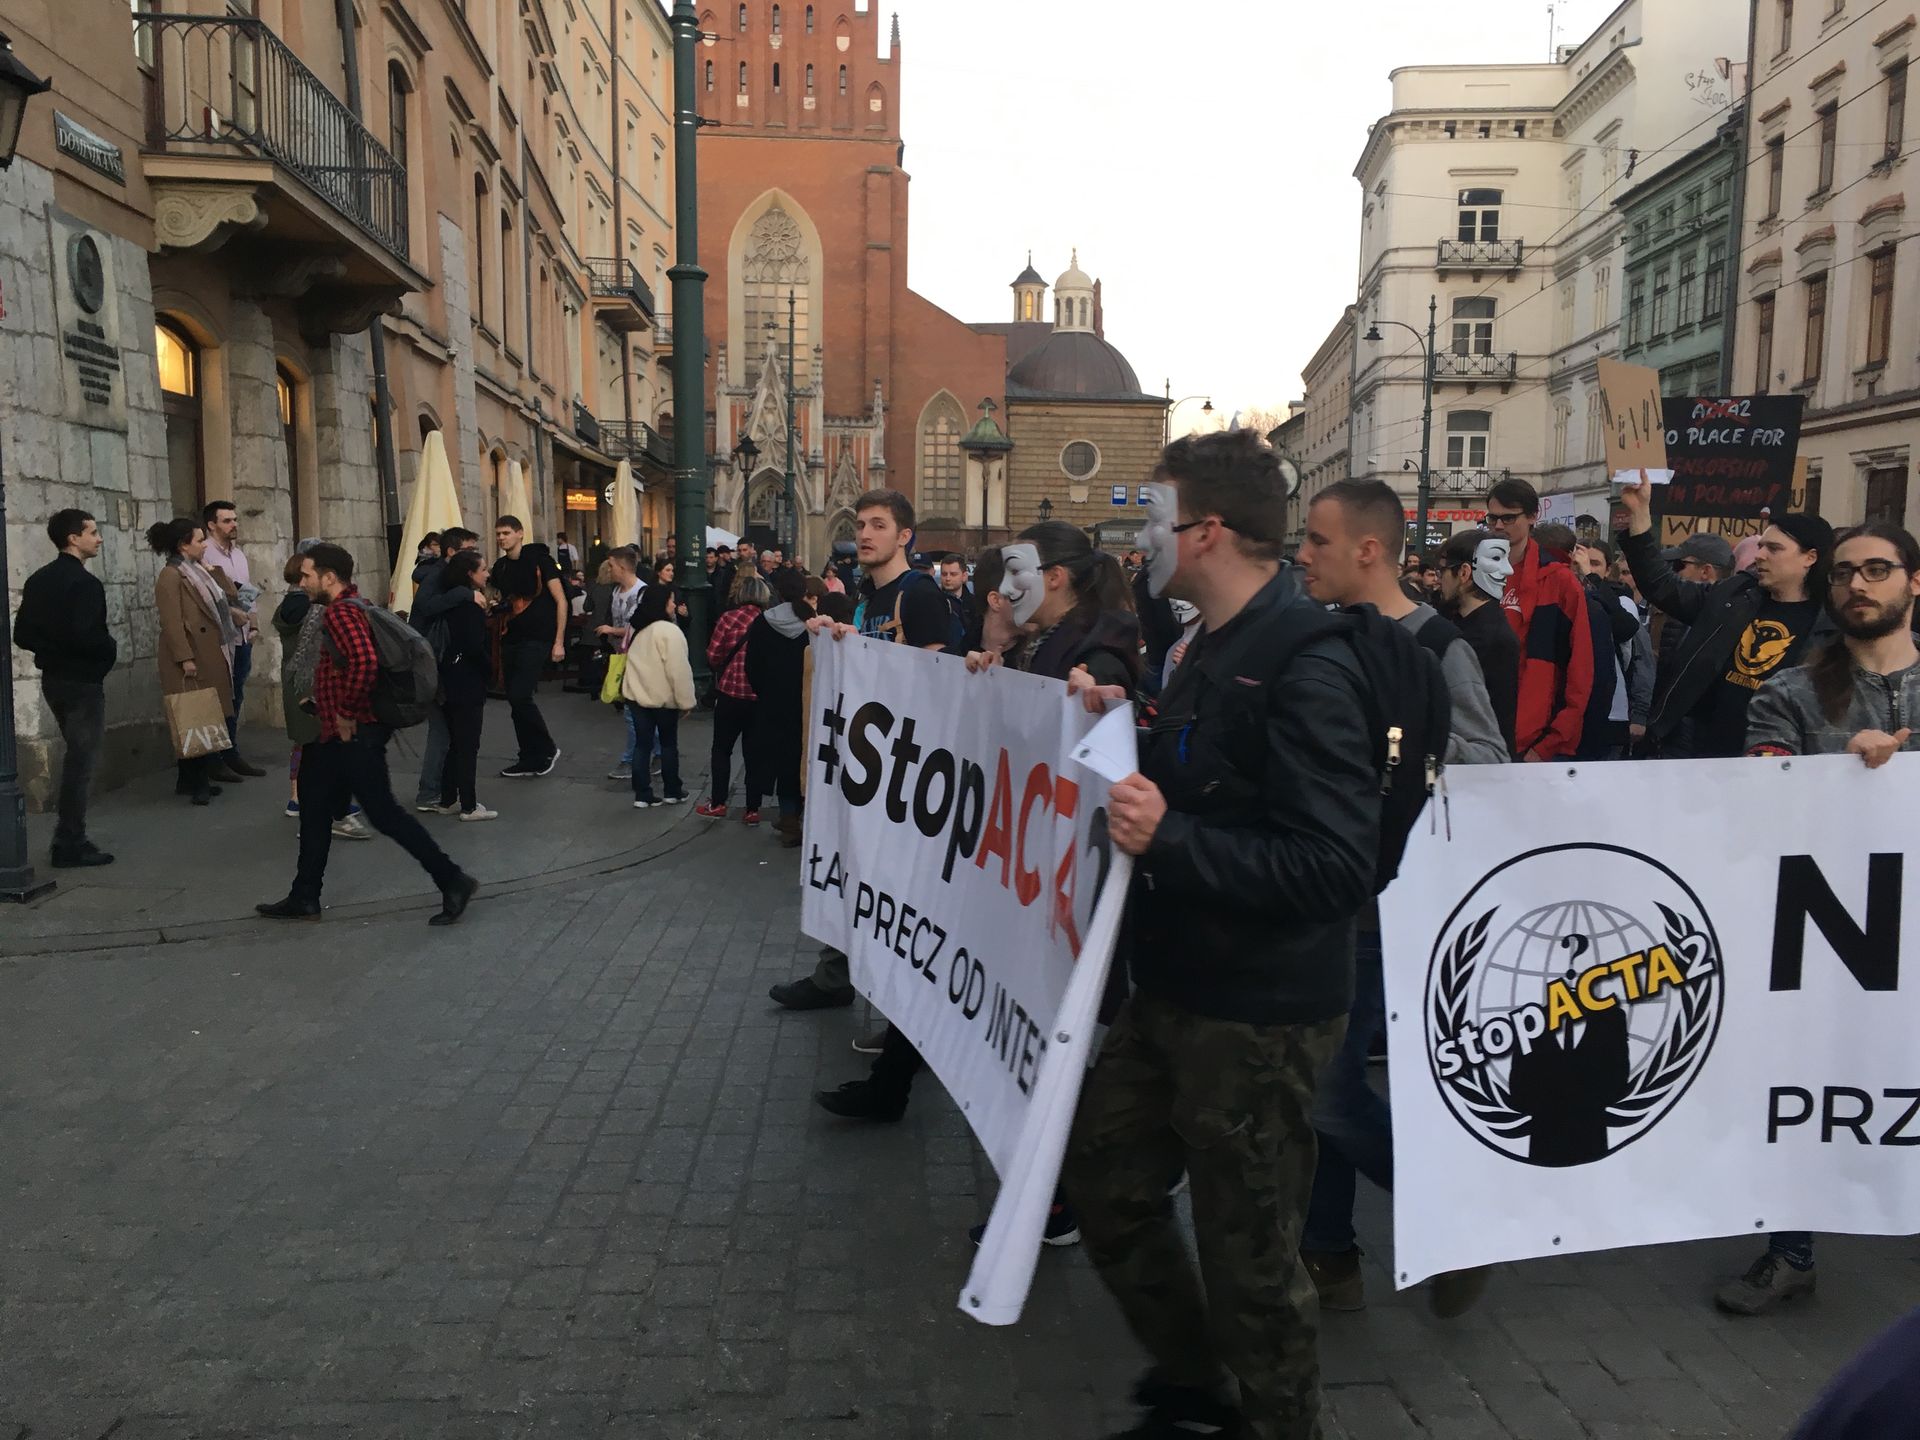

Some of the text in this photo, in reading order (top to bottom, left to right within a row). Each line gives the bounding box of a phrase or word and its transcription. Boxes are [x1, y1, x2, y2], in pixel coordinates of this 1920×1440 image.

[1665, 428, 1785, 446] O PLACE FOR
[1667, 456, 1769, 478] ENSORSHIP
[809, 843, 848, 899] ŁA
[853, 881, 947, 983] PRECZ
[949, 947, 985, 1020] OD
